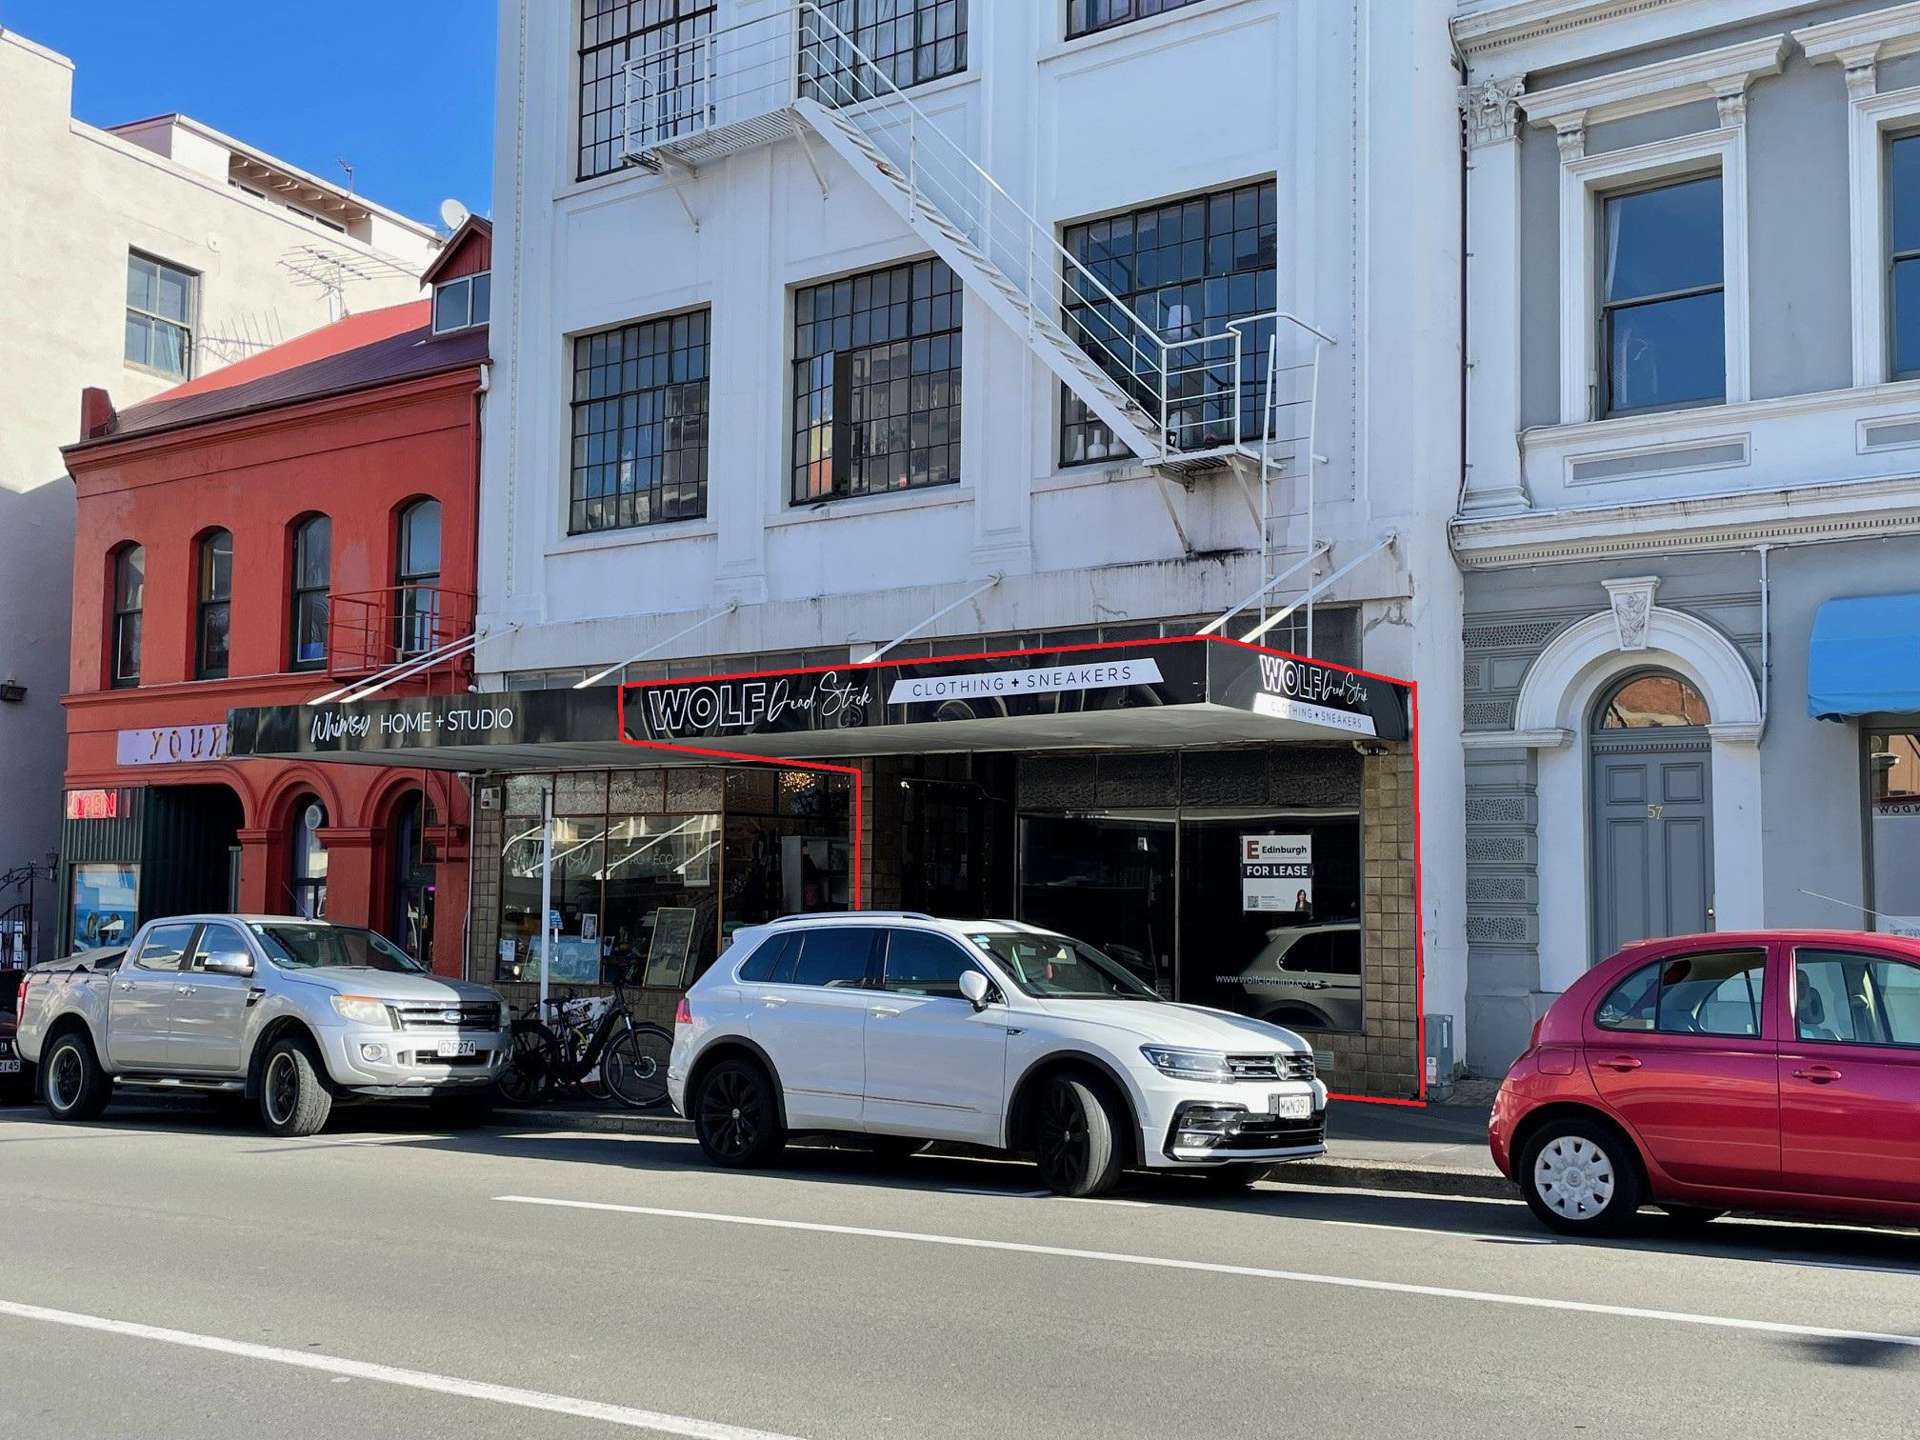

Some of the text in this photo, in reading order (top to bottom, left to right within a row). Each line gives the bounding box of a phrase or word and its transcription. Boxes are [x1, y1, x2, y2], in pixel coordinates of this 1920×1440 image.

[912, 677, 1004, 697] CLOTHING
[1027, 666, 1132, 688] SNEAKERS
[1258, 654, 1322, 700] WOLF
[648, 682, 766, 731] WOLF
[767, 678, 818, 723] Dead
[310, 711, 371, 743] Whimsy
[380, 711, 433, 735] HOME
[447, 707, 514, 731] STUDIO
[1321, 710, 1362, 729] SNEAKERS
[70, 792, 117, 817] OPEN
[1648, 804, 1664, 820] 57
[1262, 845, 1307, 856] Edinburgh
[1247, 865, 1308, 876] FOR LEASE
